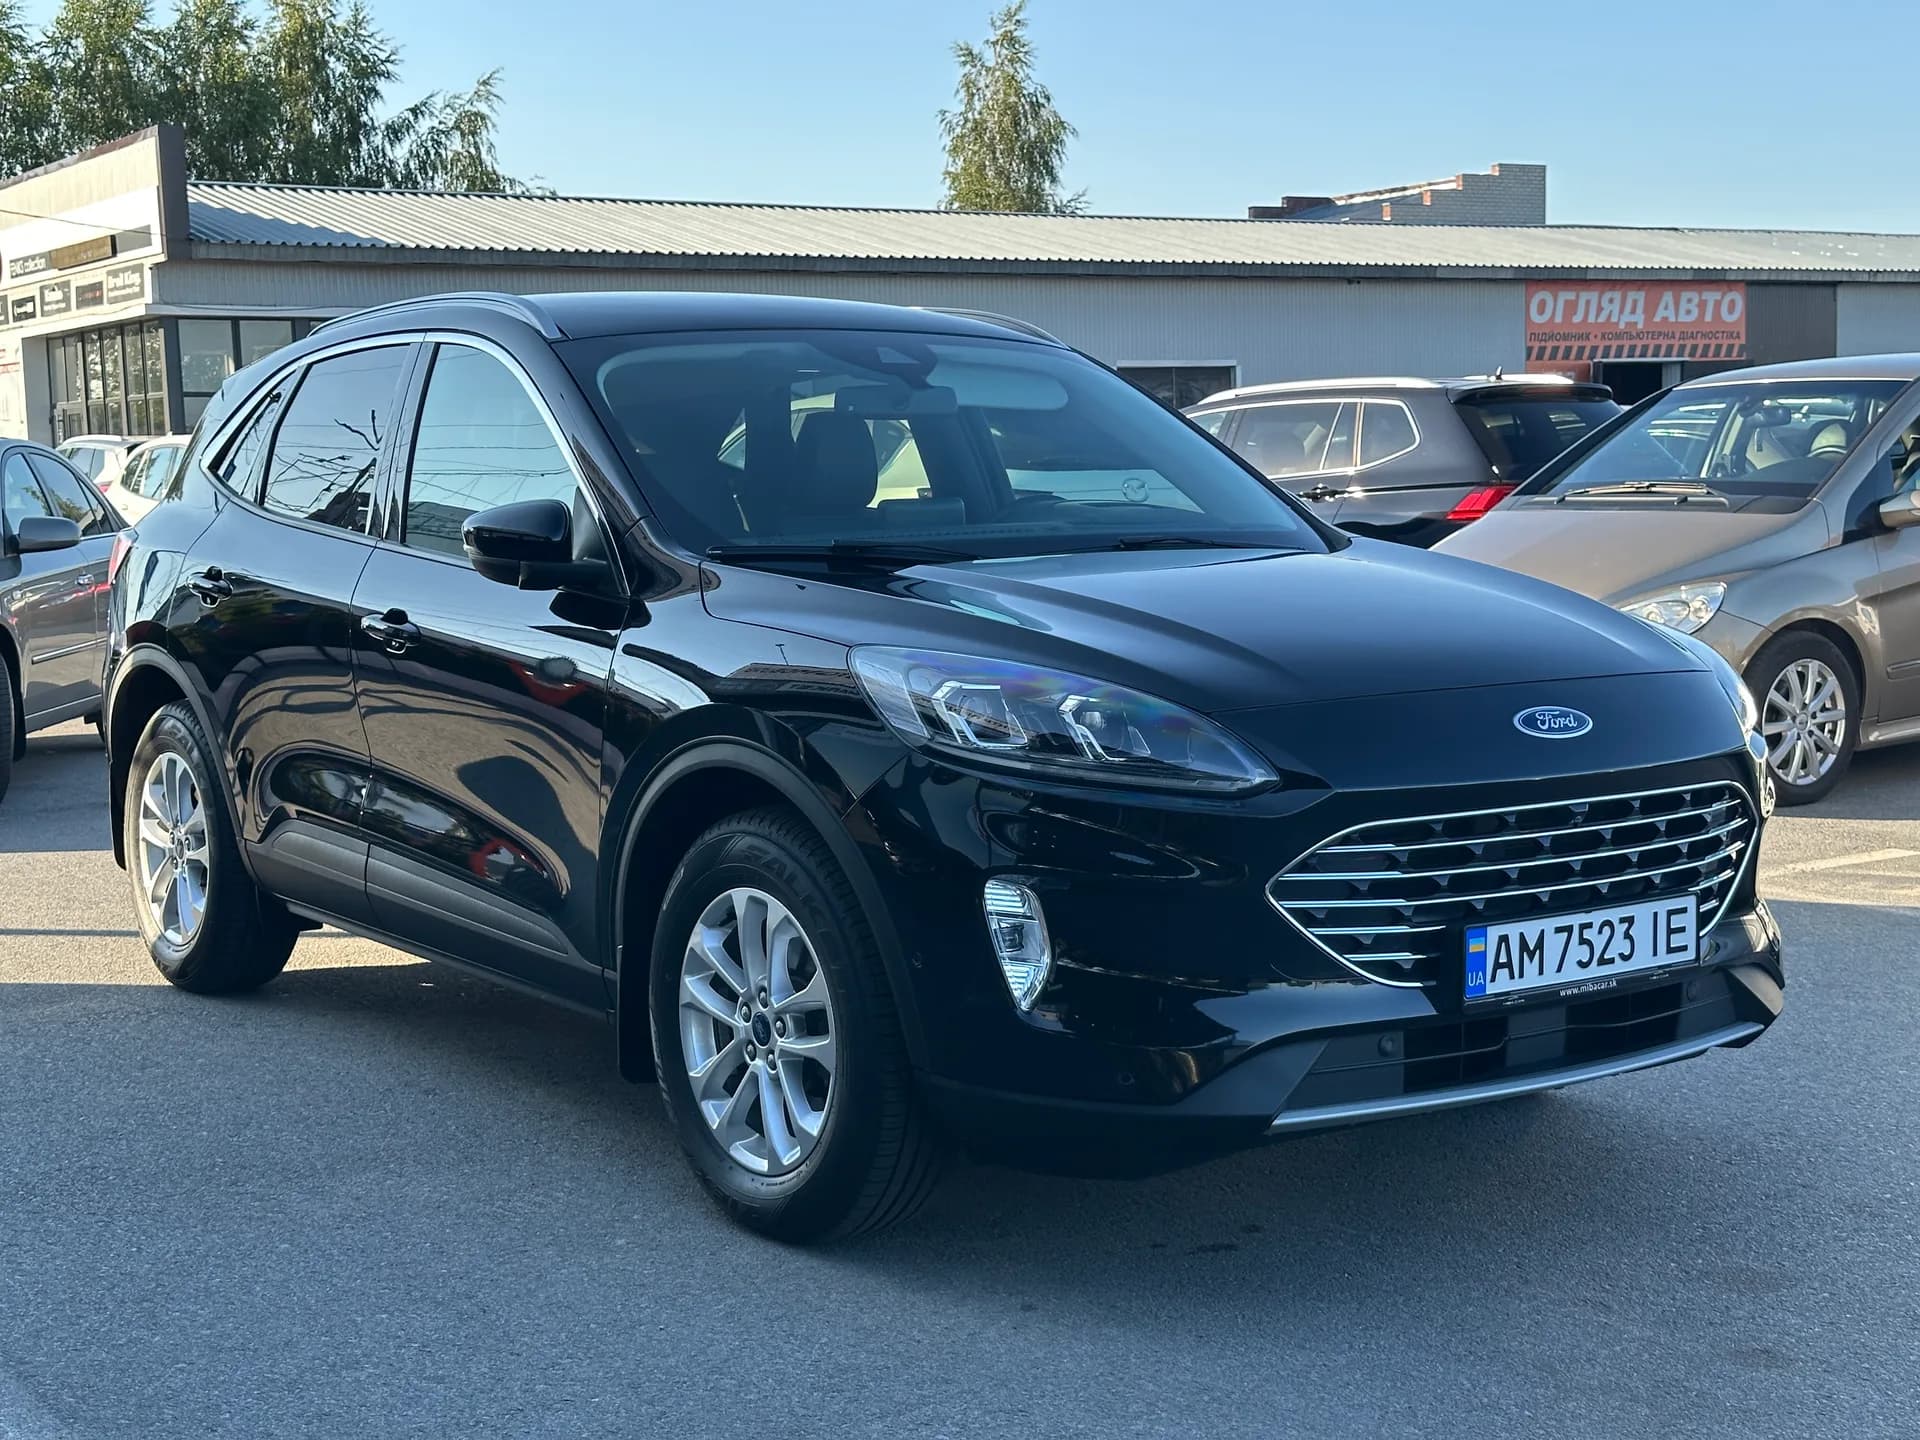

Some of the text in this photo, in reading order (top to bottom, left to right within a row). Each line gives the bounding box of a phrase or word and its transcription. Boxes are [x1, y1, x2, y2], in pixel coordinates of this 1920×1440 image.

[1529, 290, 1744, 329] ОГЛЯД АВТО
[1535, 711, 1578, 730] Ford
[1489, 906, 1689, 983] AM 7523 IE
[1468, 971, 1485, 987] UA
